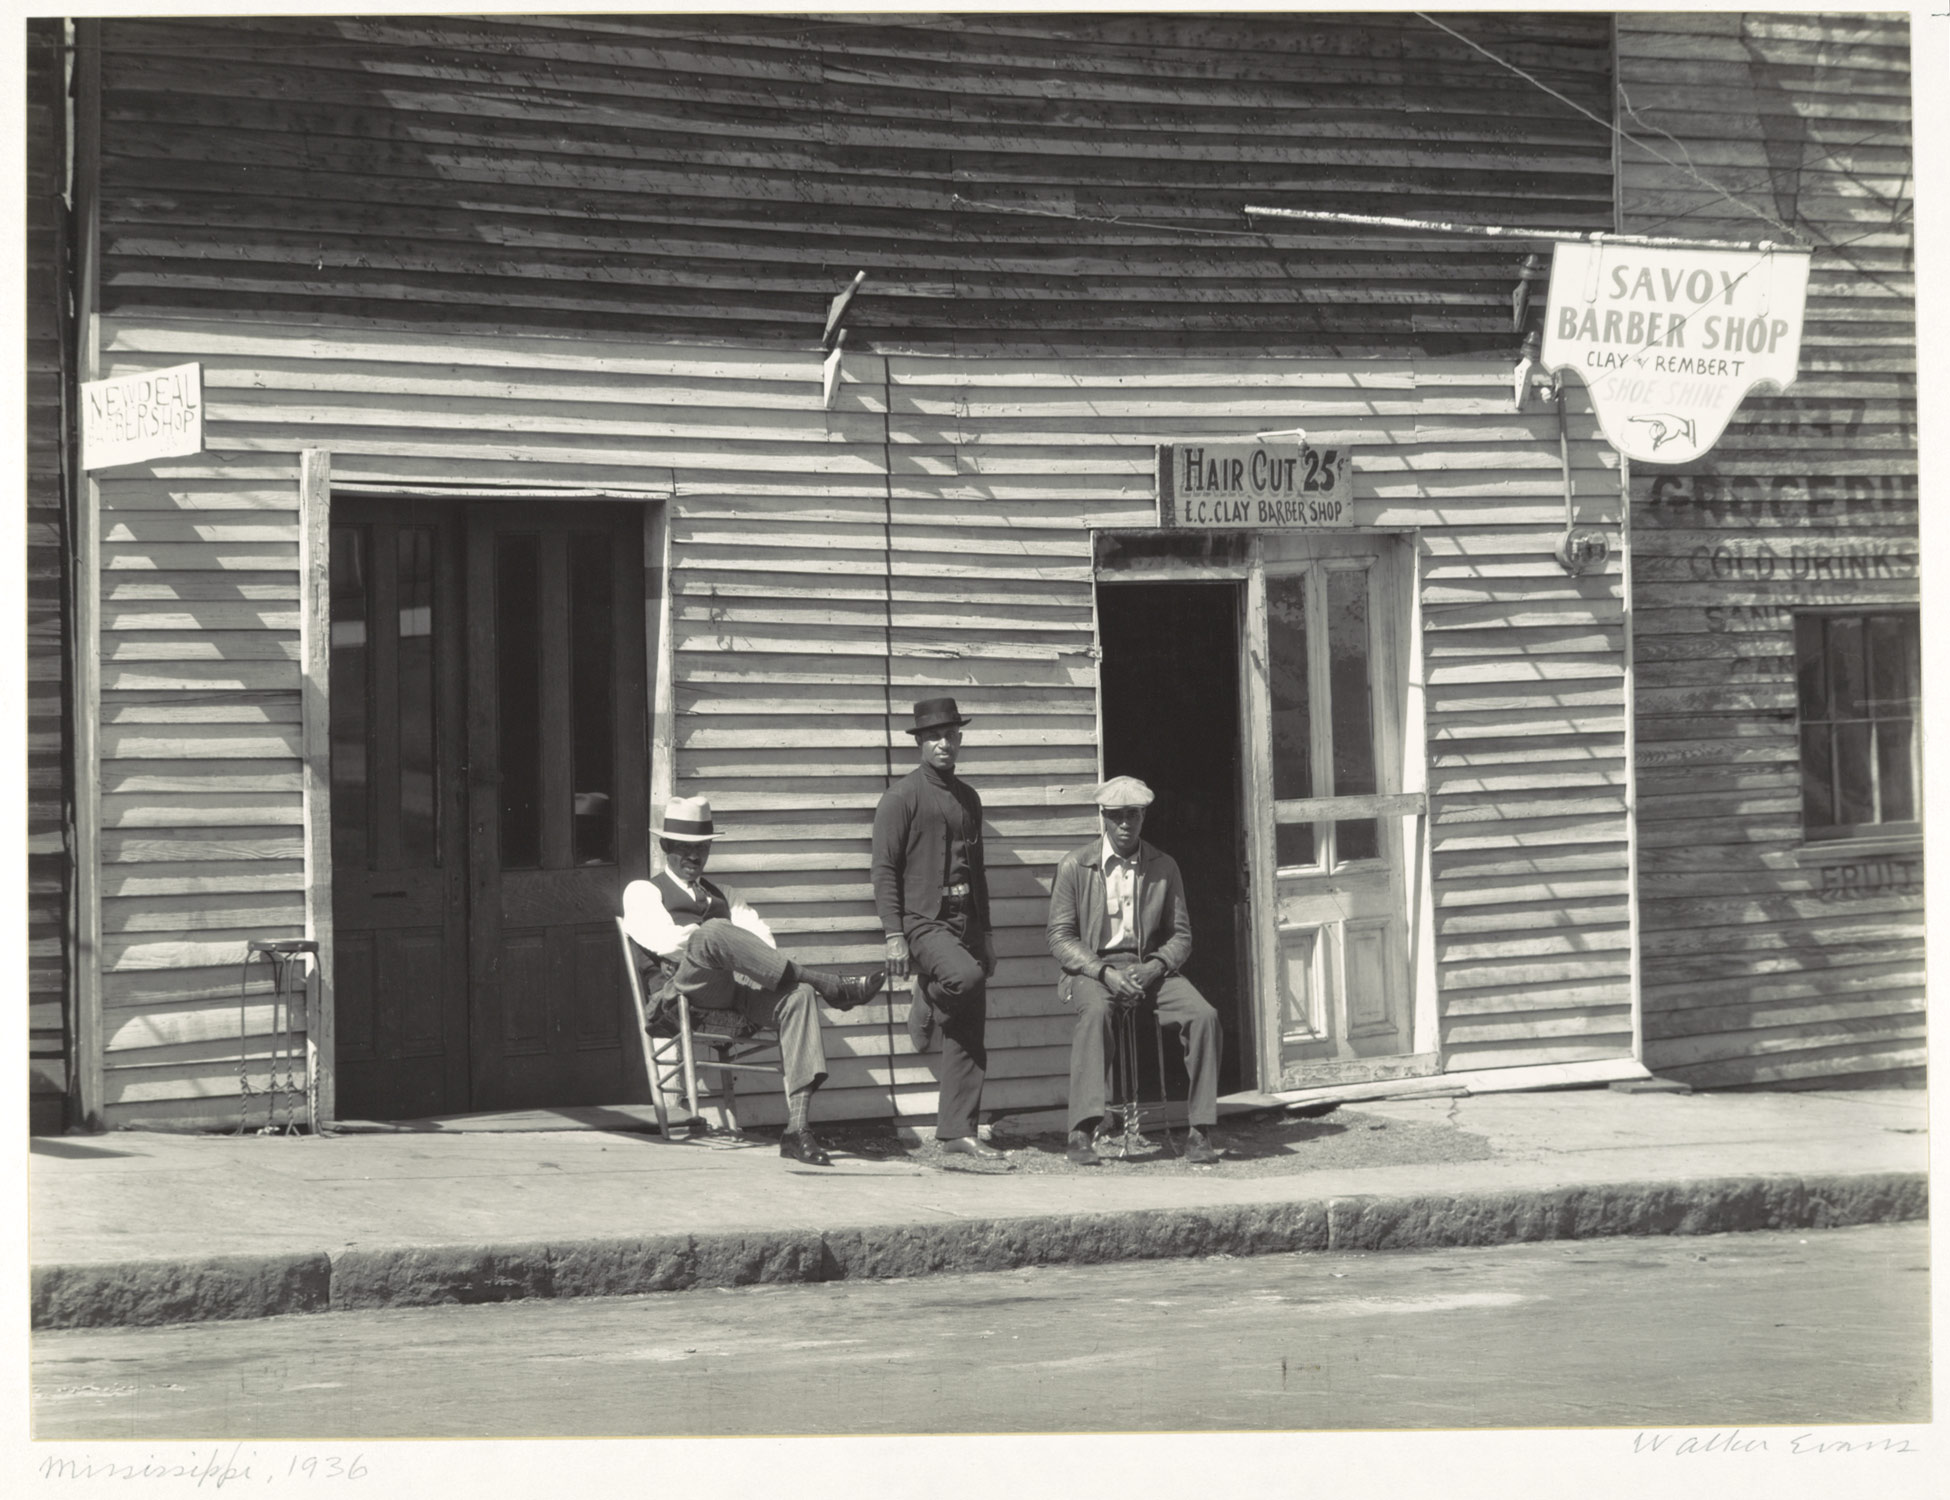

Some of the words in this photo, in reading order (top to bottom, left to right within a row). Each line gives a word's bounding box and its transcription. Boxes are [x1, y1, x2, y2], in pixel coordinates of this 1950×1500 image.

[1608, 263, 1746, 306] SAVOY
[1556, 305, 1688, 348] BARBER
[1701, 314, 1790, 355] SHOP
[1586, 350, 1629, 369] CLAY
[1654, 354, 1746, 378] REMBERT
[138, 373, 198, 410] DEAL
[1602, 377, 1659, 404] SHOE
[1663, 382, 1731, 409] SHINE
[1184, 448, 1244, 492] HAIR
[1252, 450, 1297, 492] CUT
[1257, 500, 1308, 525] BARBER
[1309, 501, 1342, 522] SHOP
[1689, 545, 1775, 581] COLD
[1790, 543, 1916, 581] DRINKS
[1633, 1429, 1768, 1456] Walker
[1790, 1433, 1919, 1455] Evans
[287, 1453, 368, 1480] 1936
